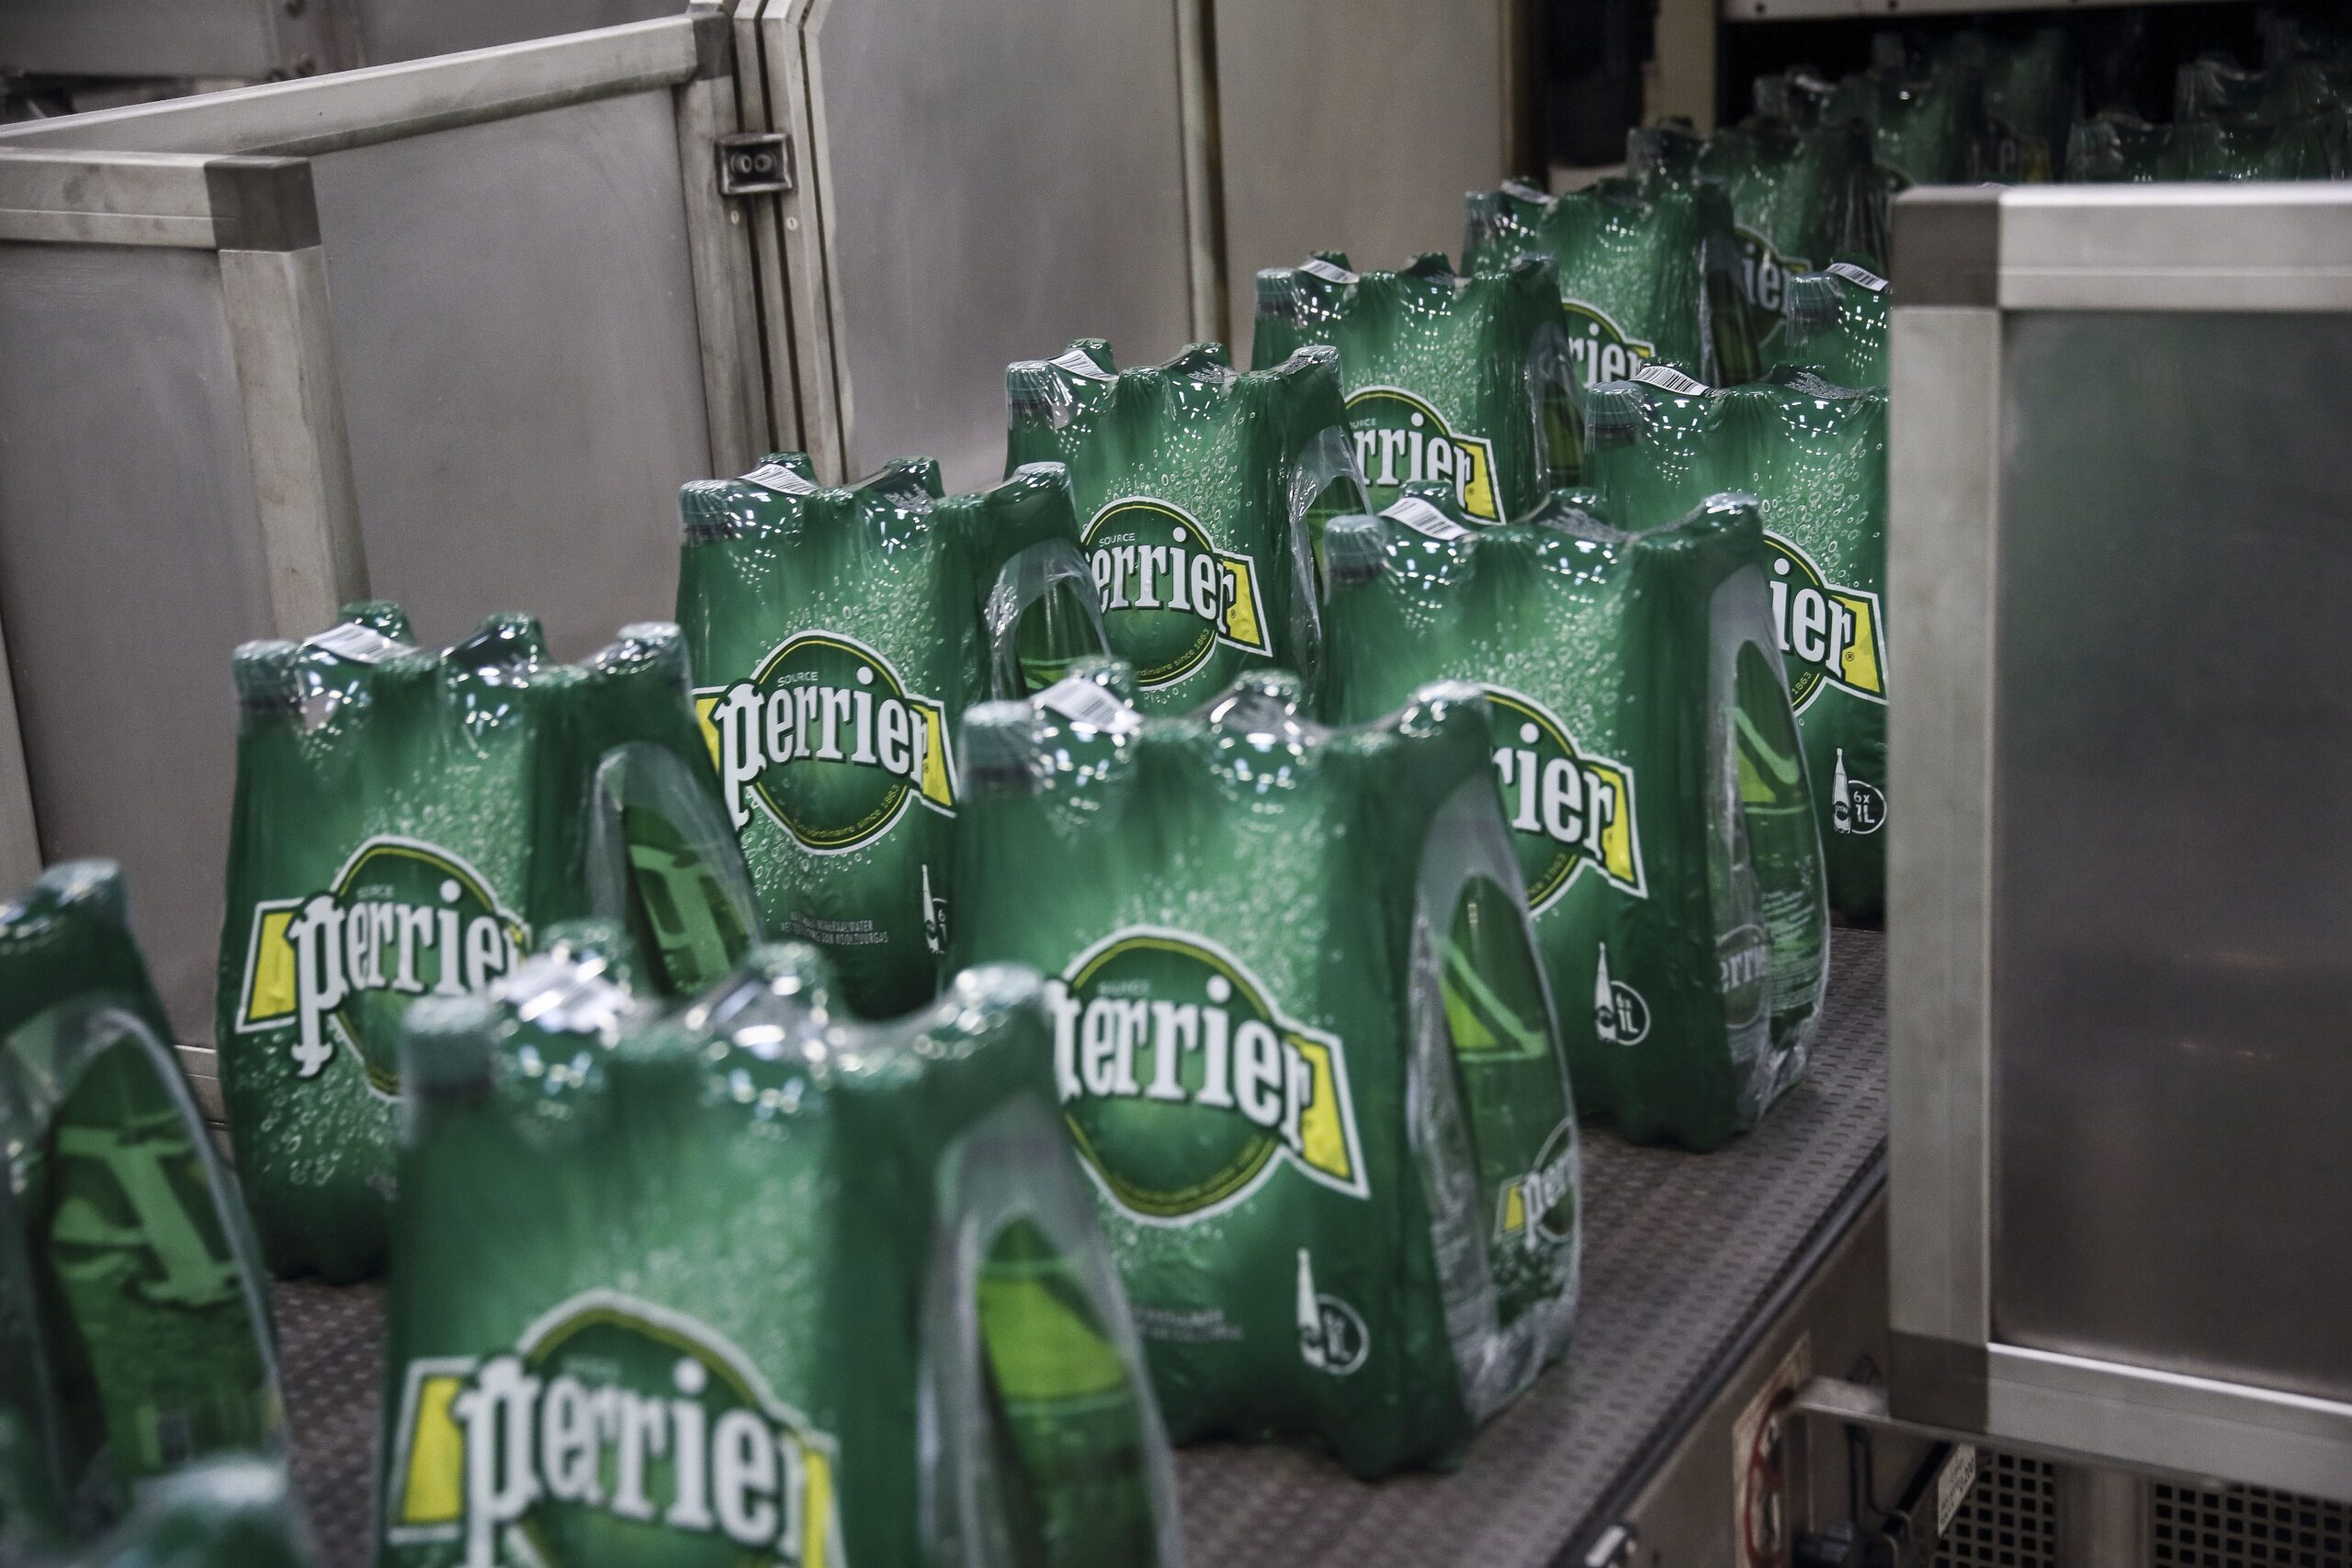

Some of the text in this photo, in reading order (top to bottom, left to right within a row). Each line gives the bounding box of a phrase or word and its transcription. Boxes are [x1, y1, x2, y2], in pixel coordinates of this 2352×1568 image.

[1099, 532, 1136, 547] SOURCE
[777, 671, 820, 687] SOURCE
[1791, 671, 1812, 694] 1863
[1853, 790, 1871, 804] 6x
[1855, 803, 1875, 824] 1L
[1617, 1009, 1640, 1033] 1L
